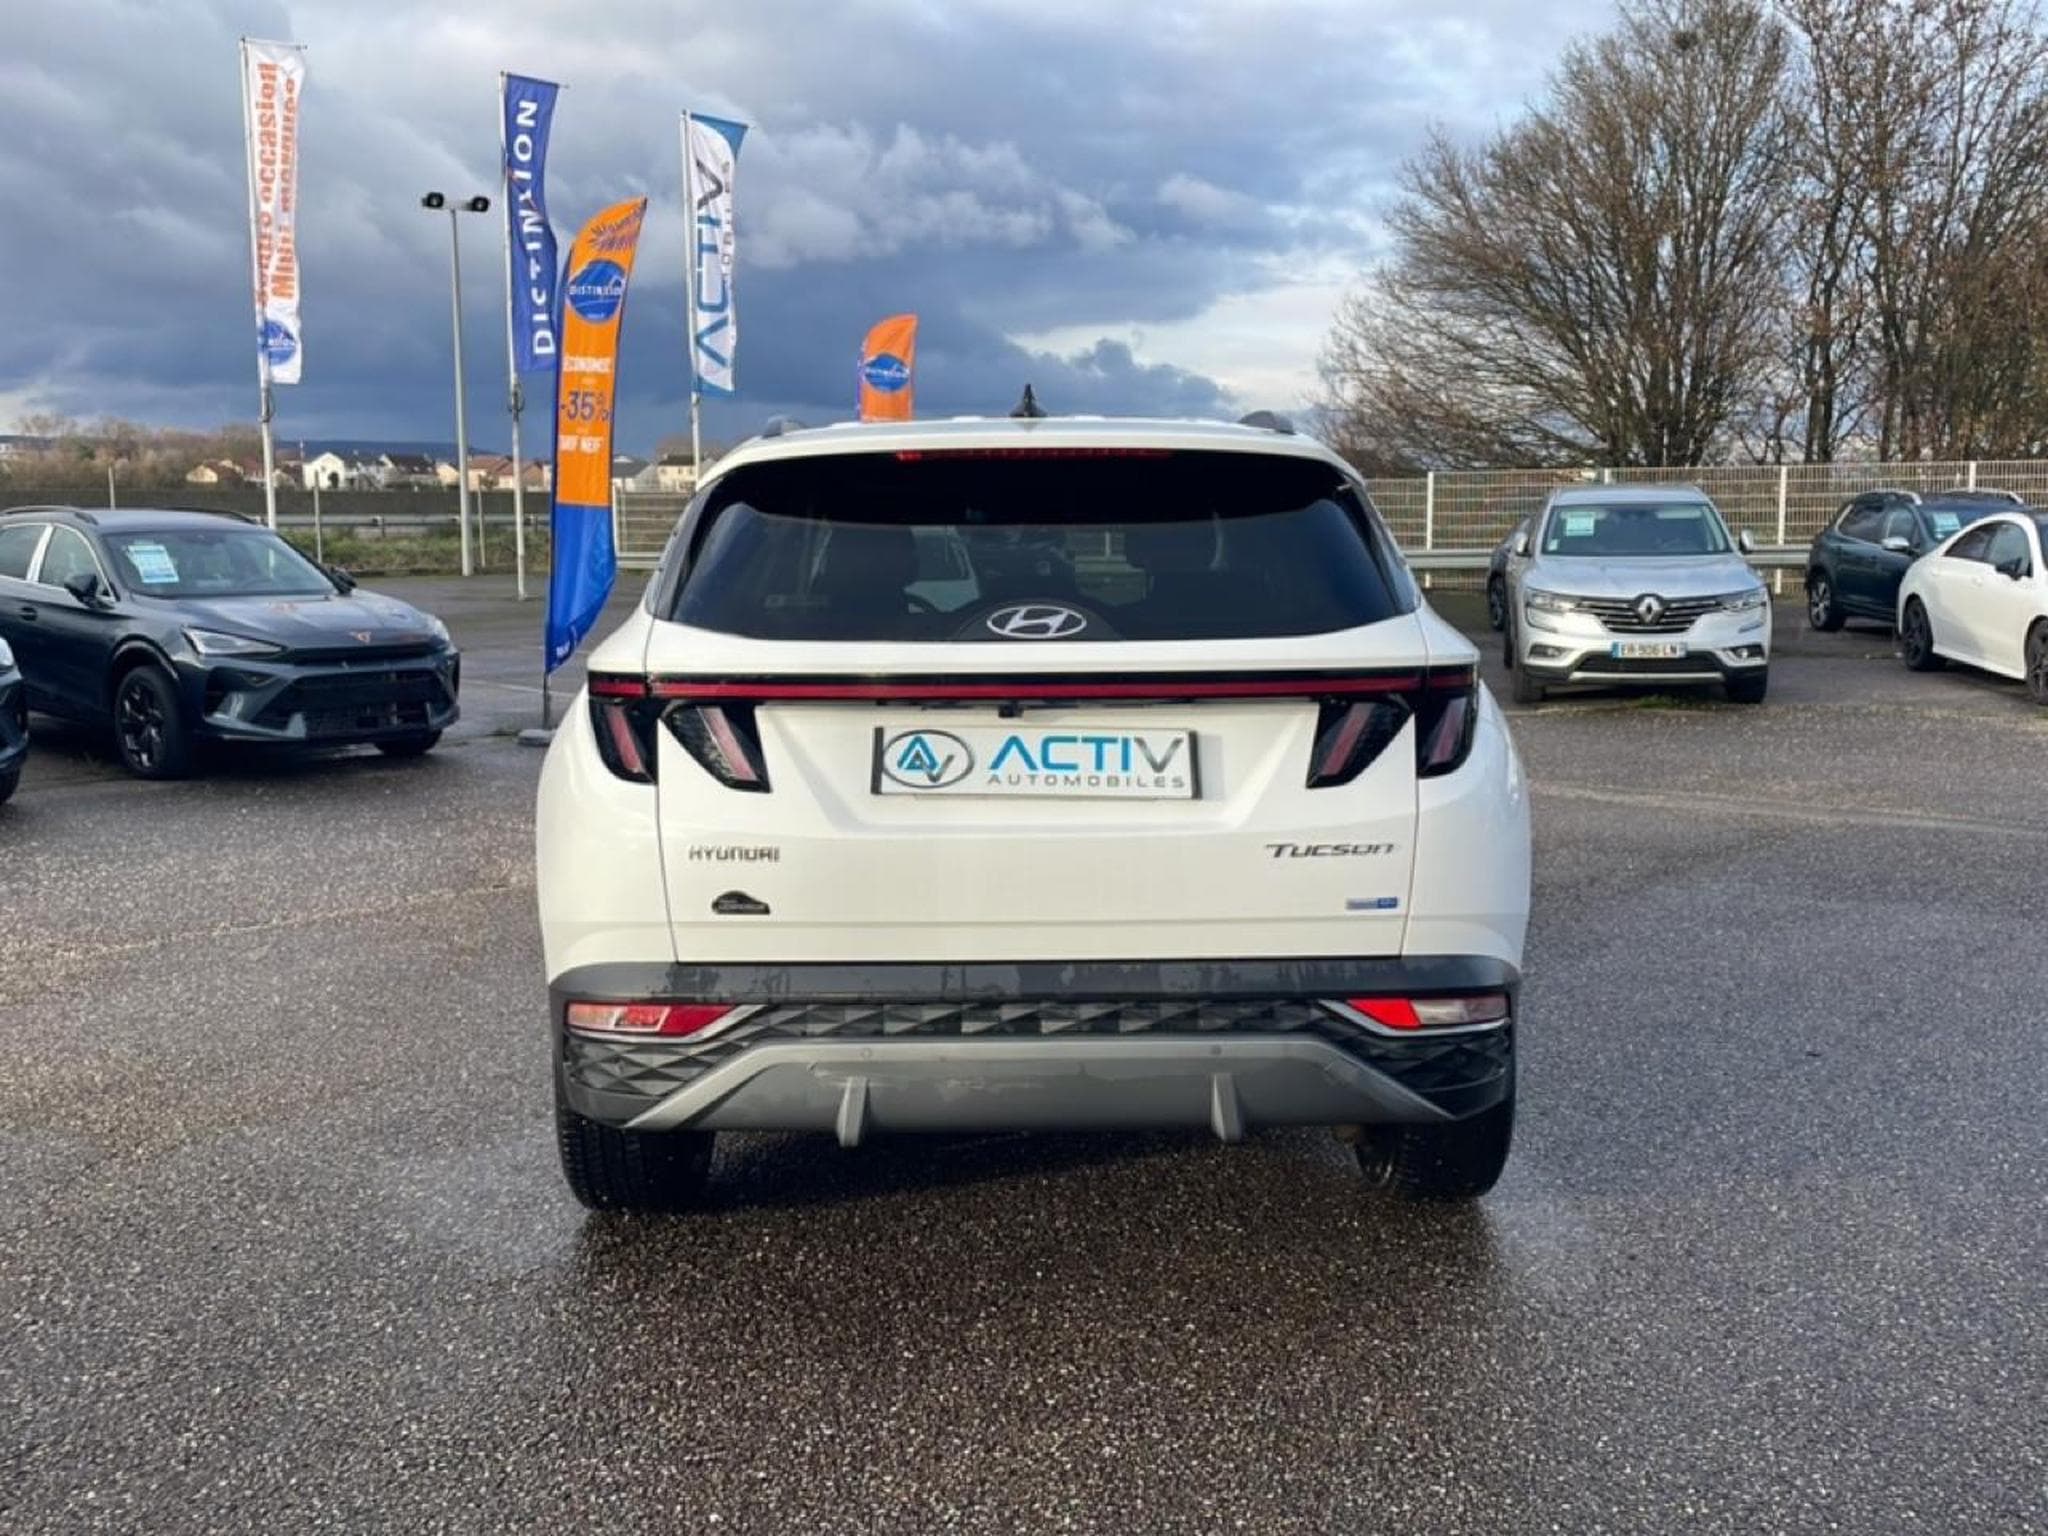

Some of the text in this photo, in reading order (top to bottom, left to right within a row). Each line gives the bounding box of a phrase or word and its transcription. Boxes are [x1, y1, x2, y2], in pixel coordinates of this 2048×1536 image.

[257, 63, 278, 203] occasion
[695, 158, 729, 369] ACTIV
[988, 735, 1184, 773] ACTIV
[988, 774, 1185, 789] AUTOMOBILES
[688, 846, 780, 862] HYUNDAI
